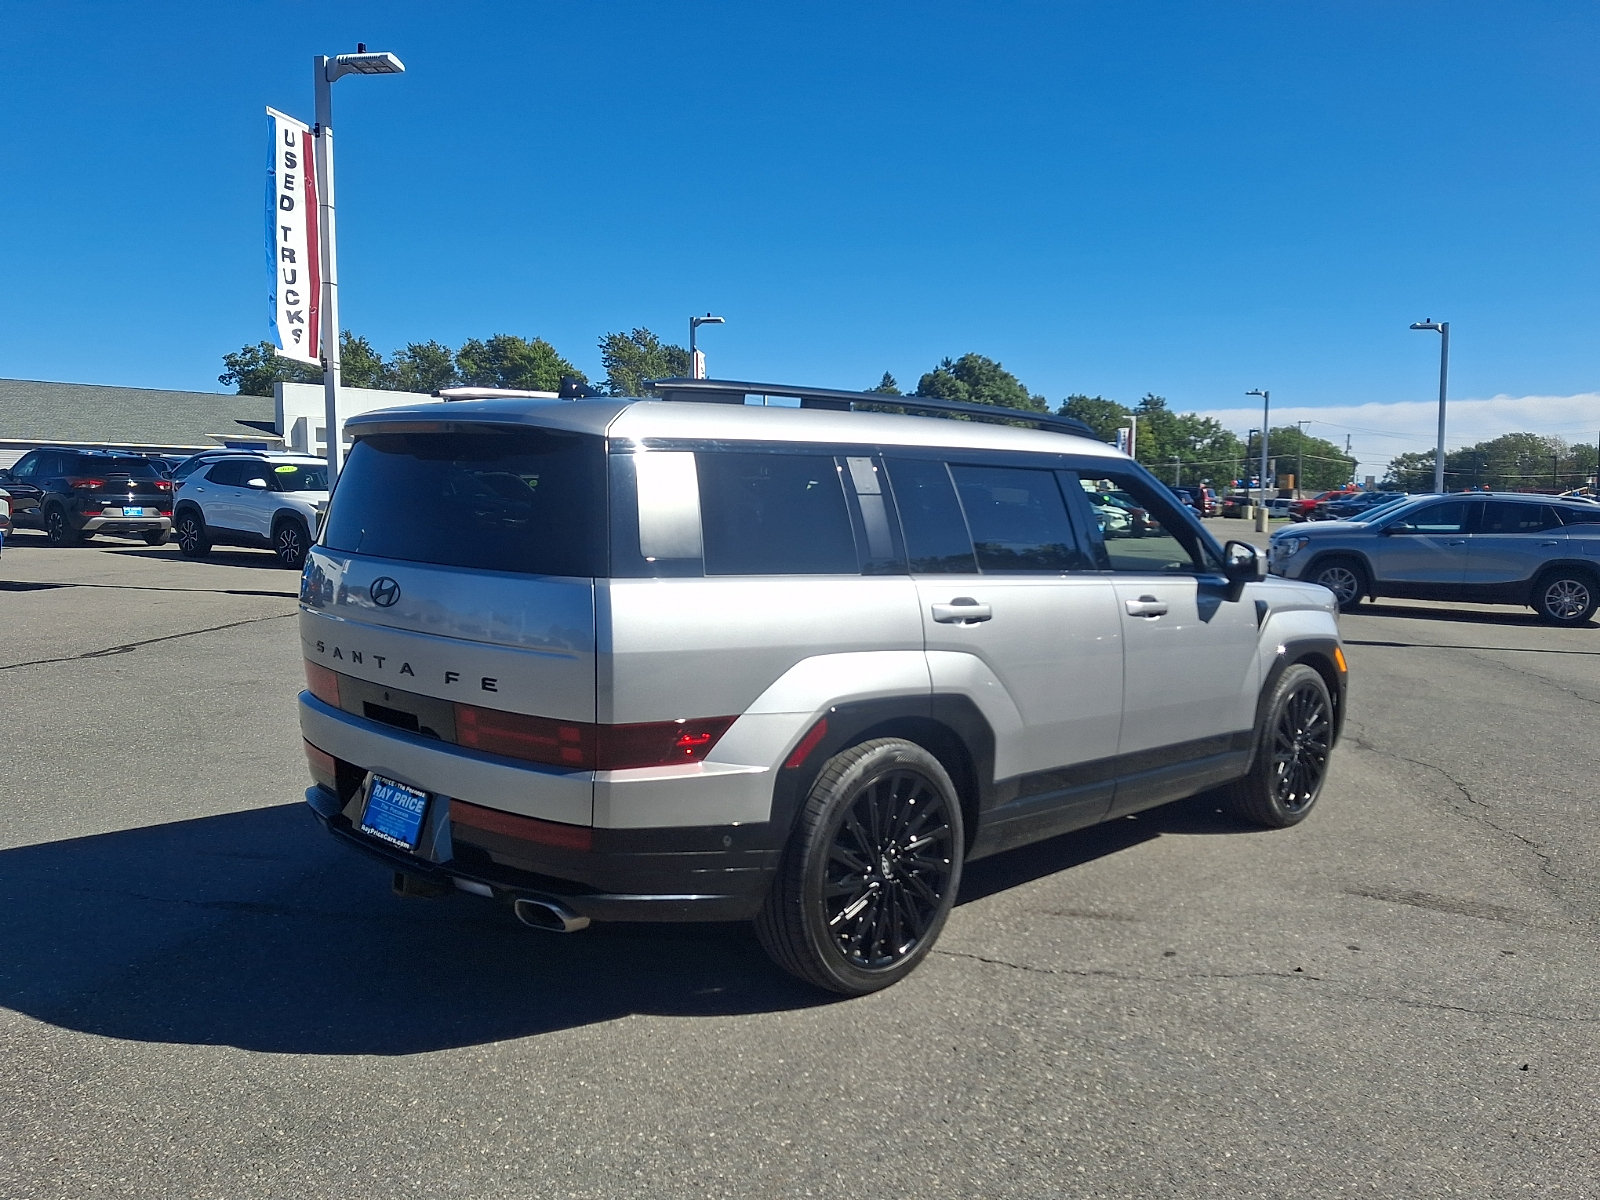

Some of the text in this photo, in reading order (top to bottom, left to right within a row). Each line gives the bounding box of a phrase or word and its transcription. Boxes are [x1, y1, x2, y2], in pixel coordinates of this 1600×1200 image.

[280, 128, 304, 344] USED TRUCKS
[316, 640, 498, 692] SANTA FE
[373, 784, 425, 813] RAY PRICE
[361, 824, 410, 849] RayPriceCars.com
